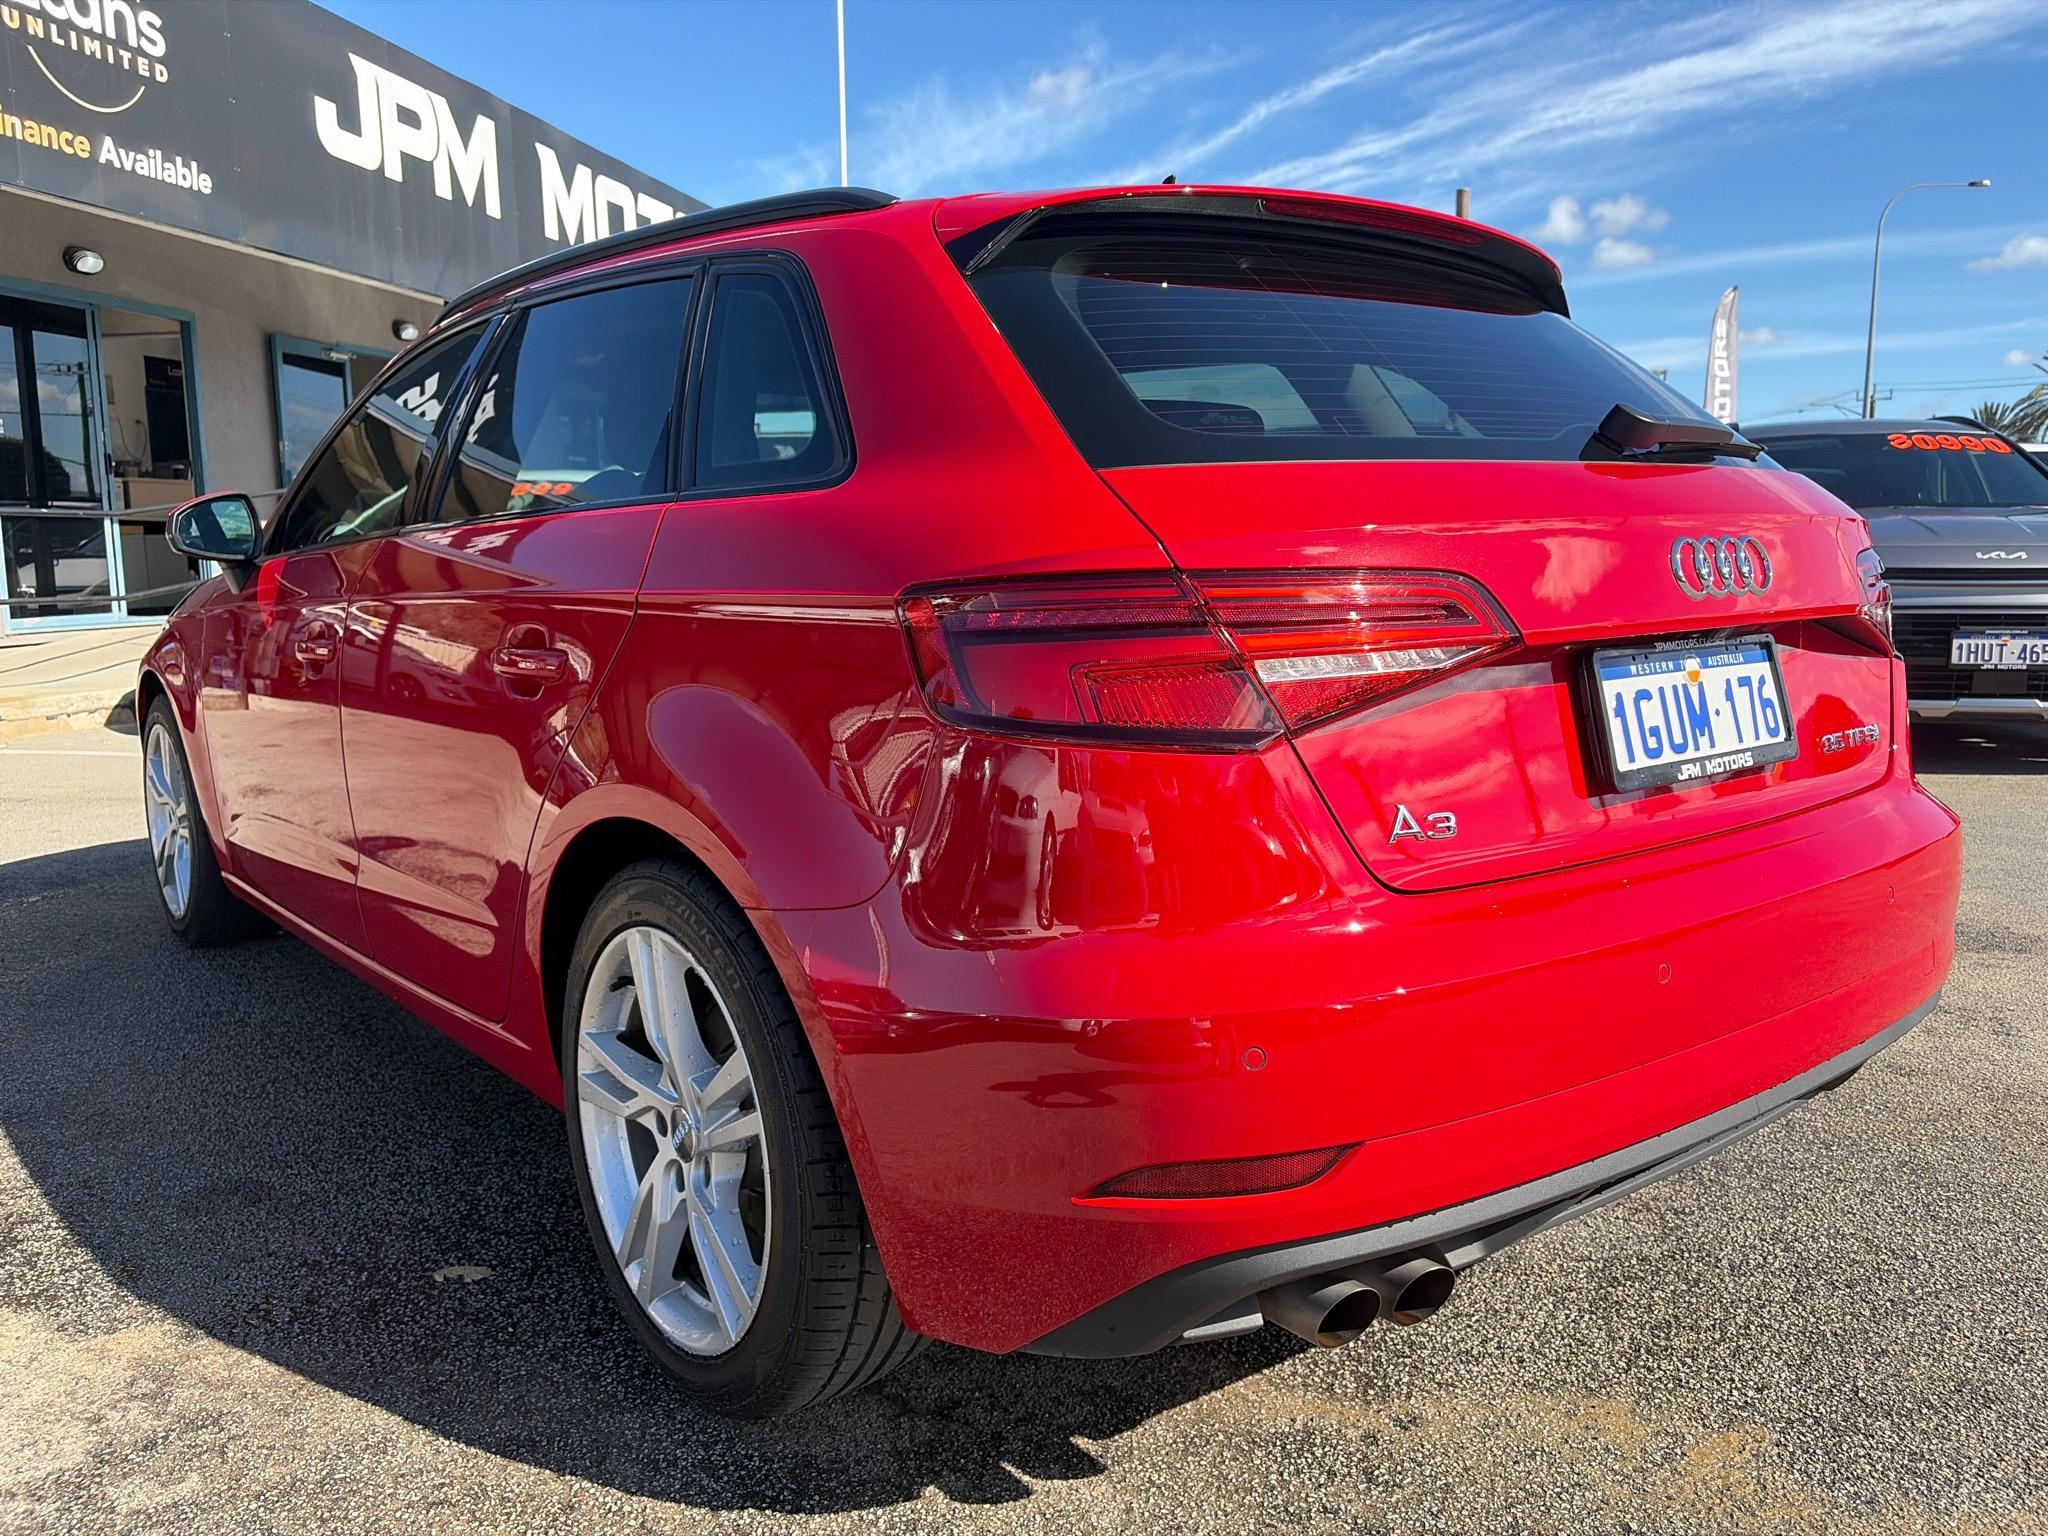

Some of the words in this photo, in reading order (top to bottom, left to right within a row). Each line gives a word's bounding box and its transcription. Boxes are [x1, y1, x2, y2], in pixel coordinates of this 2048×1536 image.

[0, 4, 169, 83] UNLIMITED
[0, 103, 91, 159] inance
[98, 135, 213, 195] Available
[314, 52, 501, 220] JPM
[534, 141, 687, 246] MOT
[1713, 317, 1732, 425] OTORS
[1629, 659, 1675, 676] WESTERN
[1707, 652, 1745, 667] AUSTRALIA
[1677, 762, 1702, 781] JPM
[1704, 751, 1754, 775] MOTORS
[1388, 803, 1457, 845] A3
